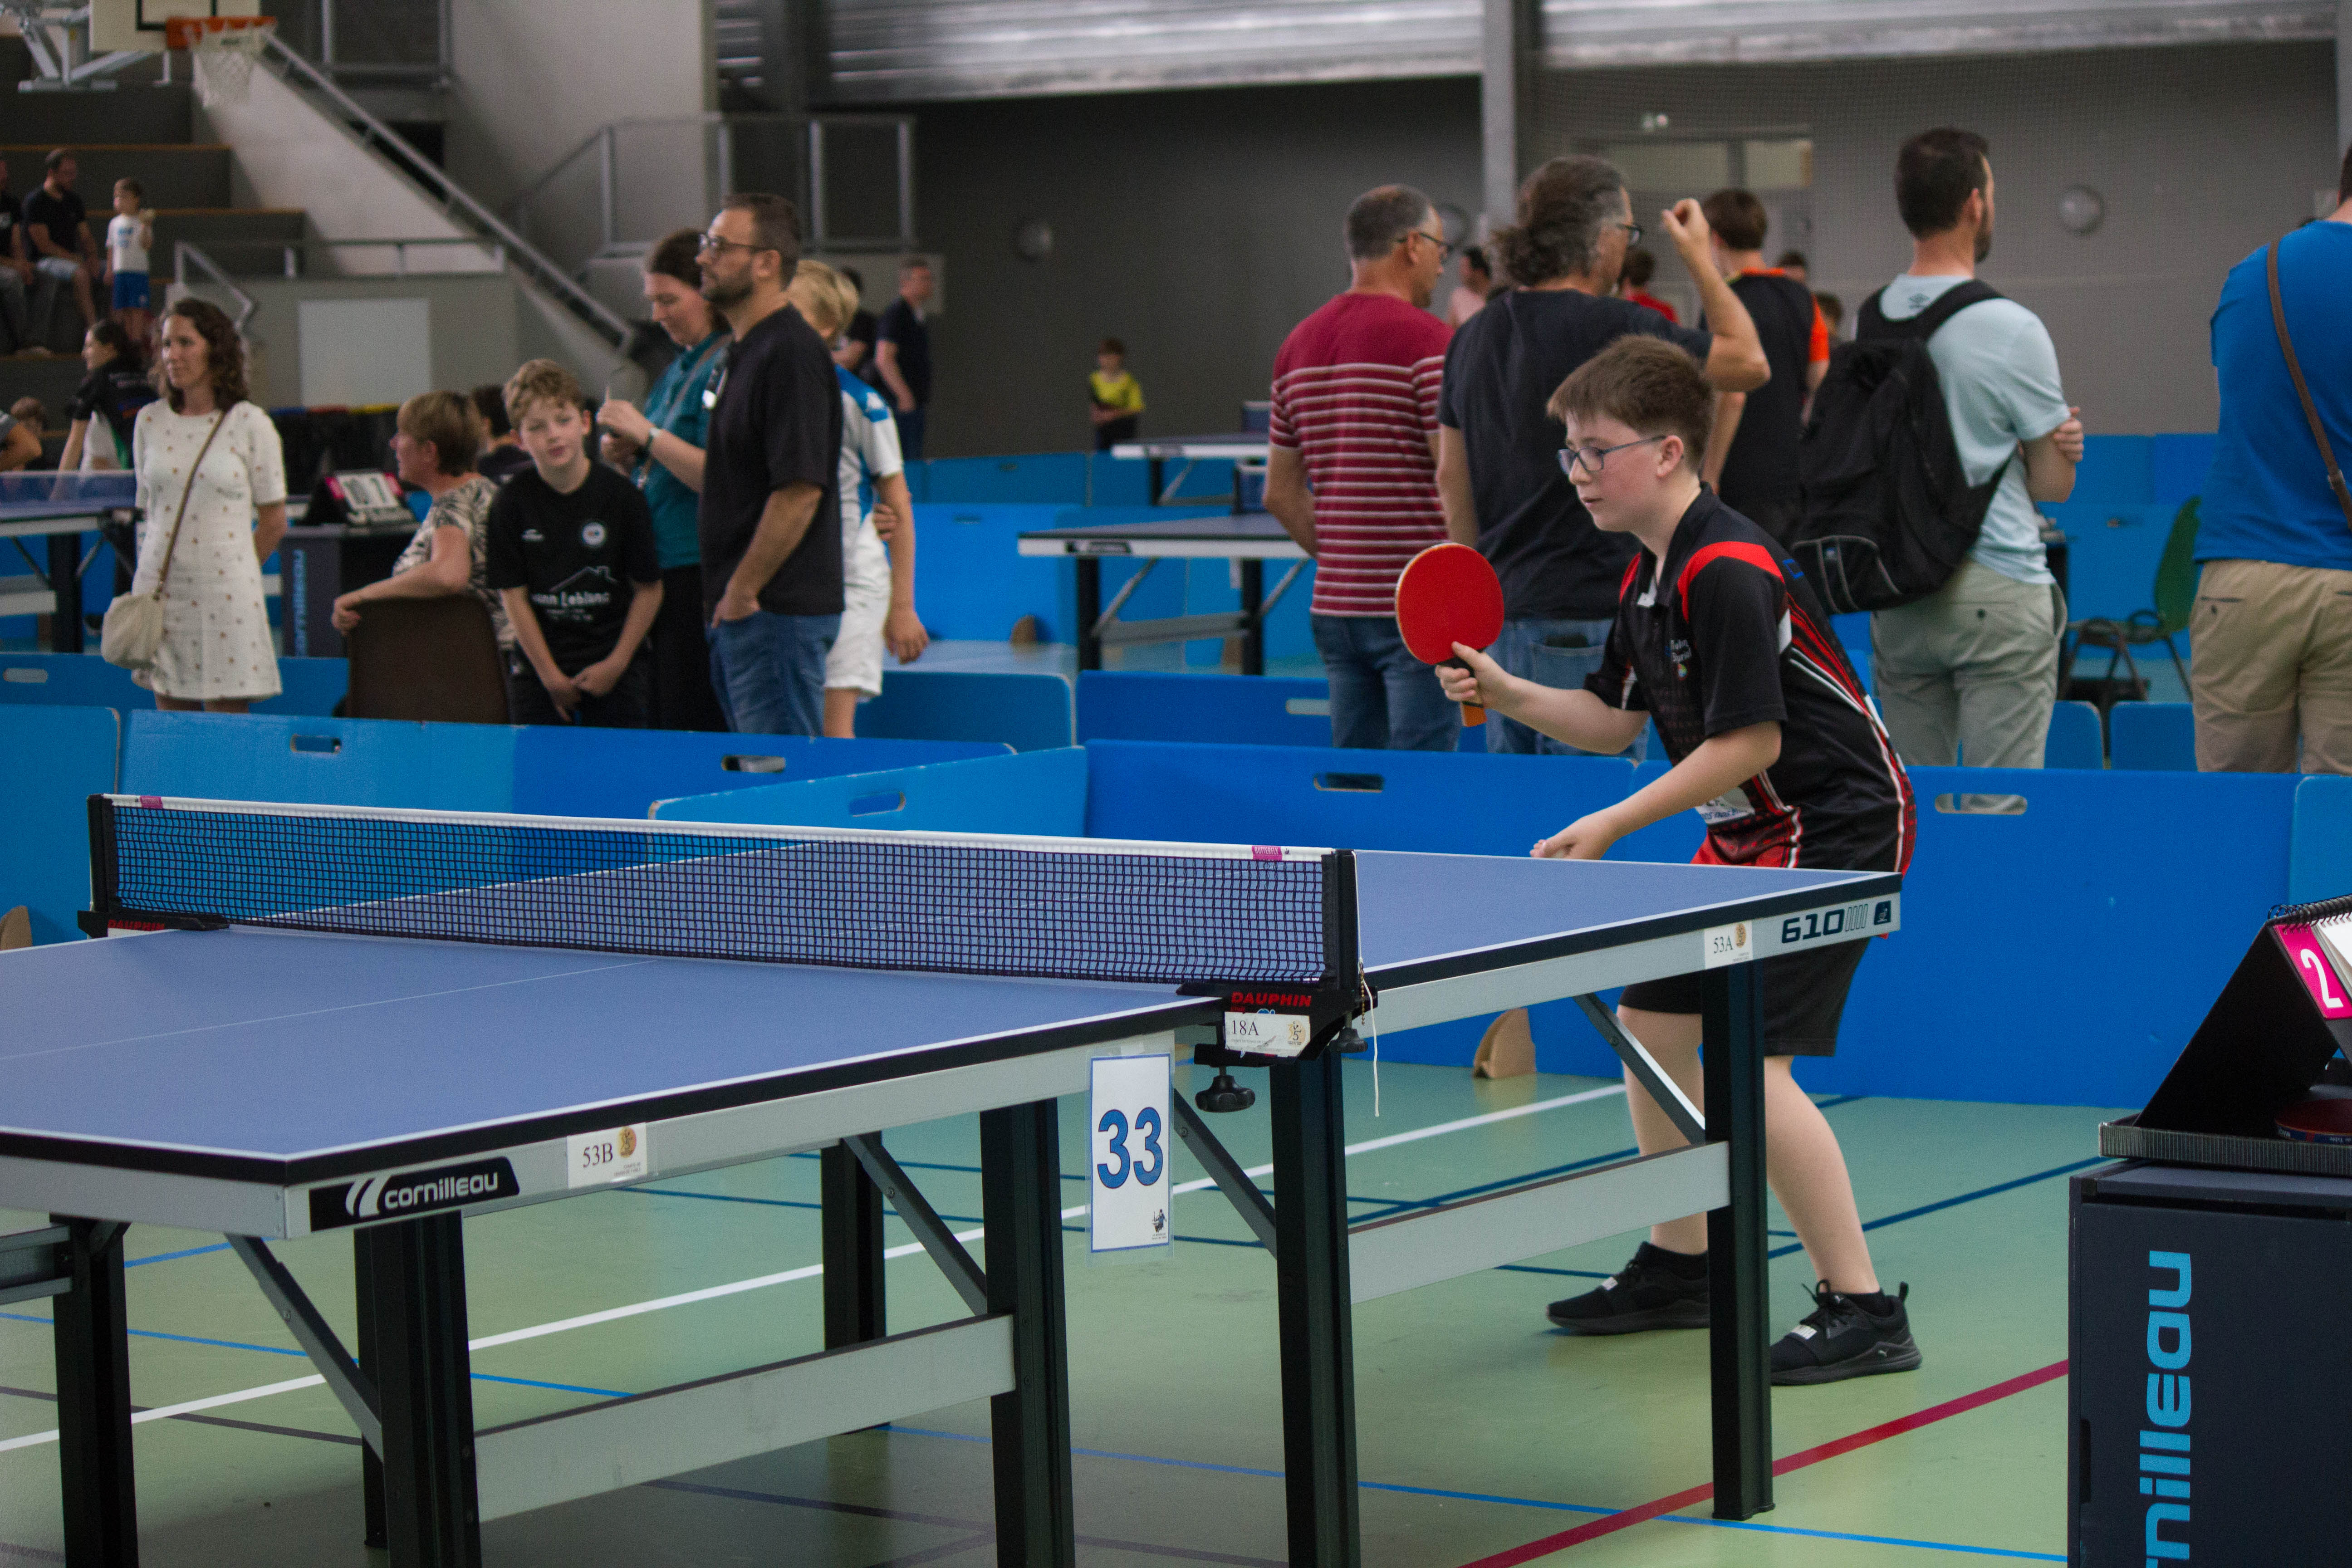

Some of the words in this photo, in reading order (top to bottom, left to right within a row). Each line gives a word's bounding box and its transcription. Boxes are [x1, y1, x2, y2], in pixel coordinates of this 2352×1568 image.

[1254, 846, 1279, 855] BUTTERFLY
[1781, 909, 1845, 943] 610
[1714, 935, 1733, 954] 53A
[2300, 948, 2344, 1008] 2
[1231, 991, 1312, 1007] DAUPHIN
[1232, 1020, 1259, 1036] 18A
[583, 1142, 613, 1168] 53B
[1097, 1107, 1163, 1189] 33
[384, 1171, 499, 1210] cornilleau
[2140, 1250, 2191, 1568] nilleau
